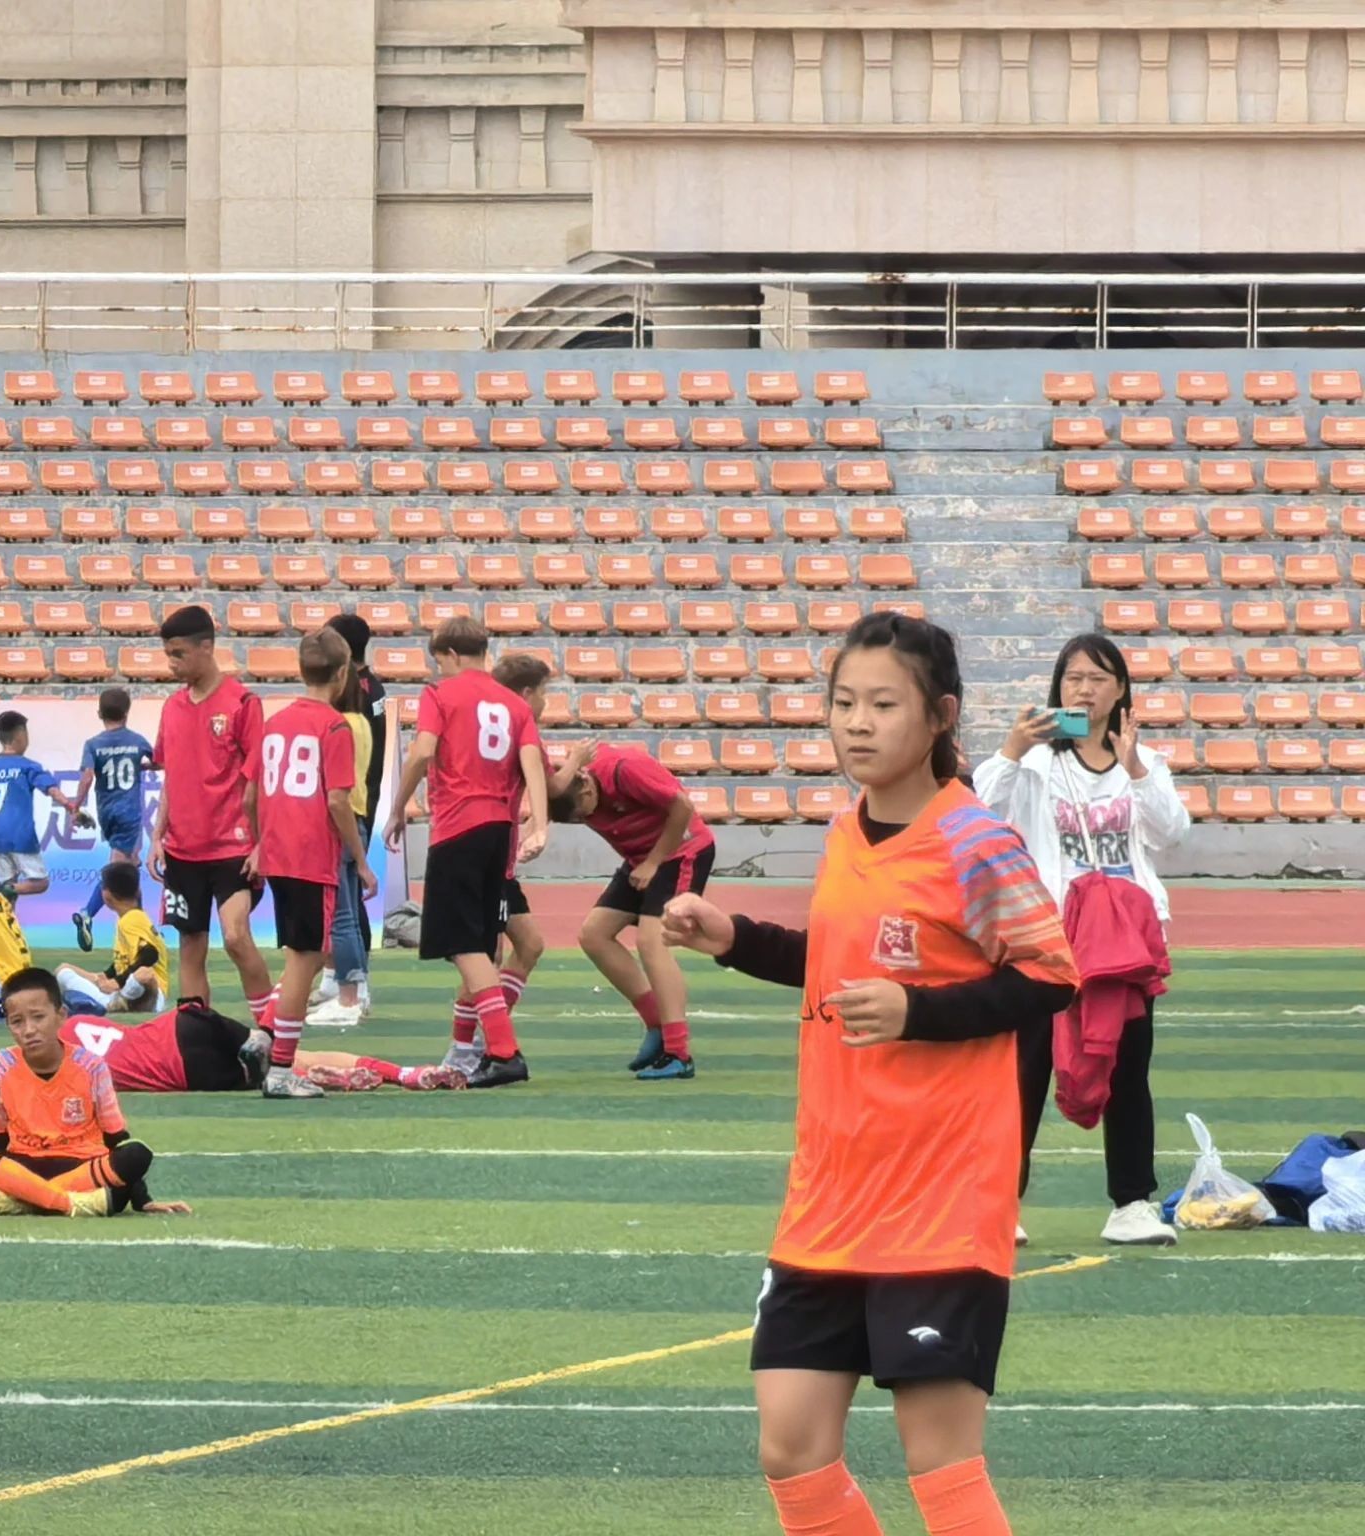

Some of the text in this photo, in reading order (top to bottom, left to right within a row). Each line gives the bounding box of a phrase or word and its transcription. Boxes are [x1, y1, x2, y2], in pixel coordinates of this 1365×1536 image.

[477, 700, 511, 761] 8
[101, 756, 135, 791] 10
[262, 733, 320, 798] 88
